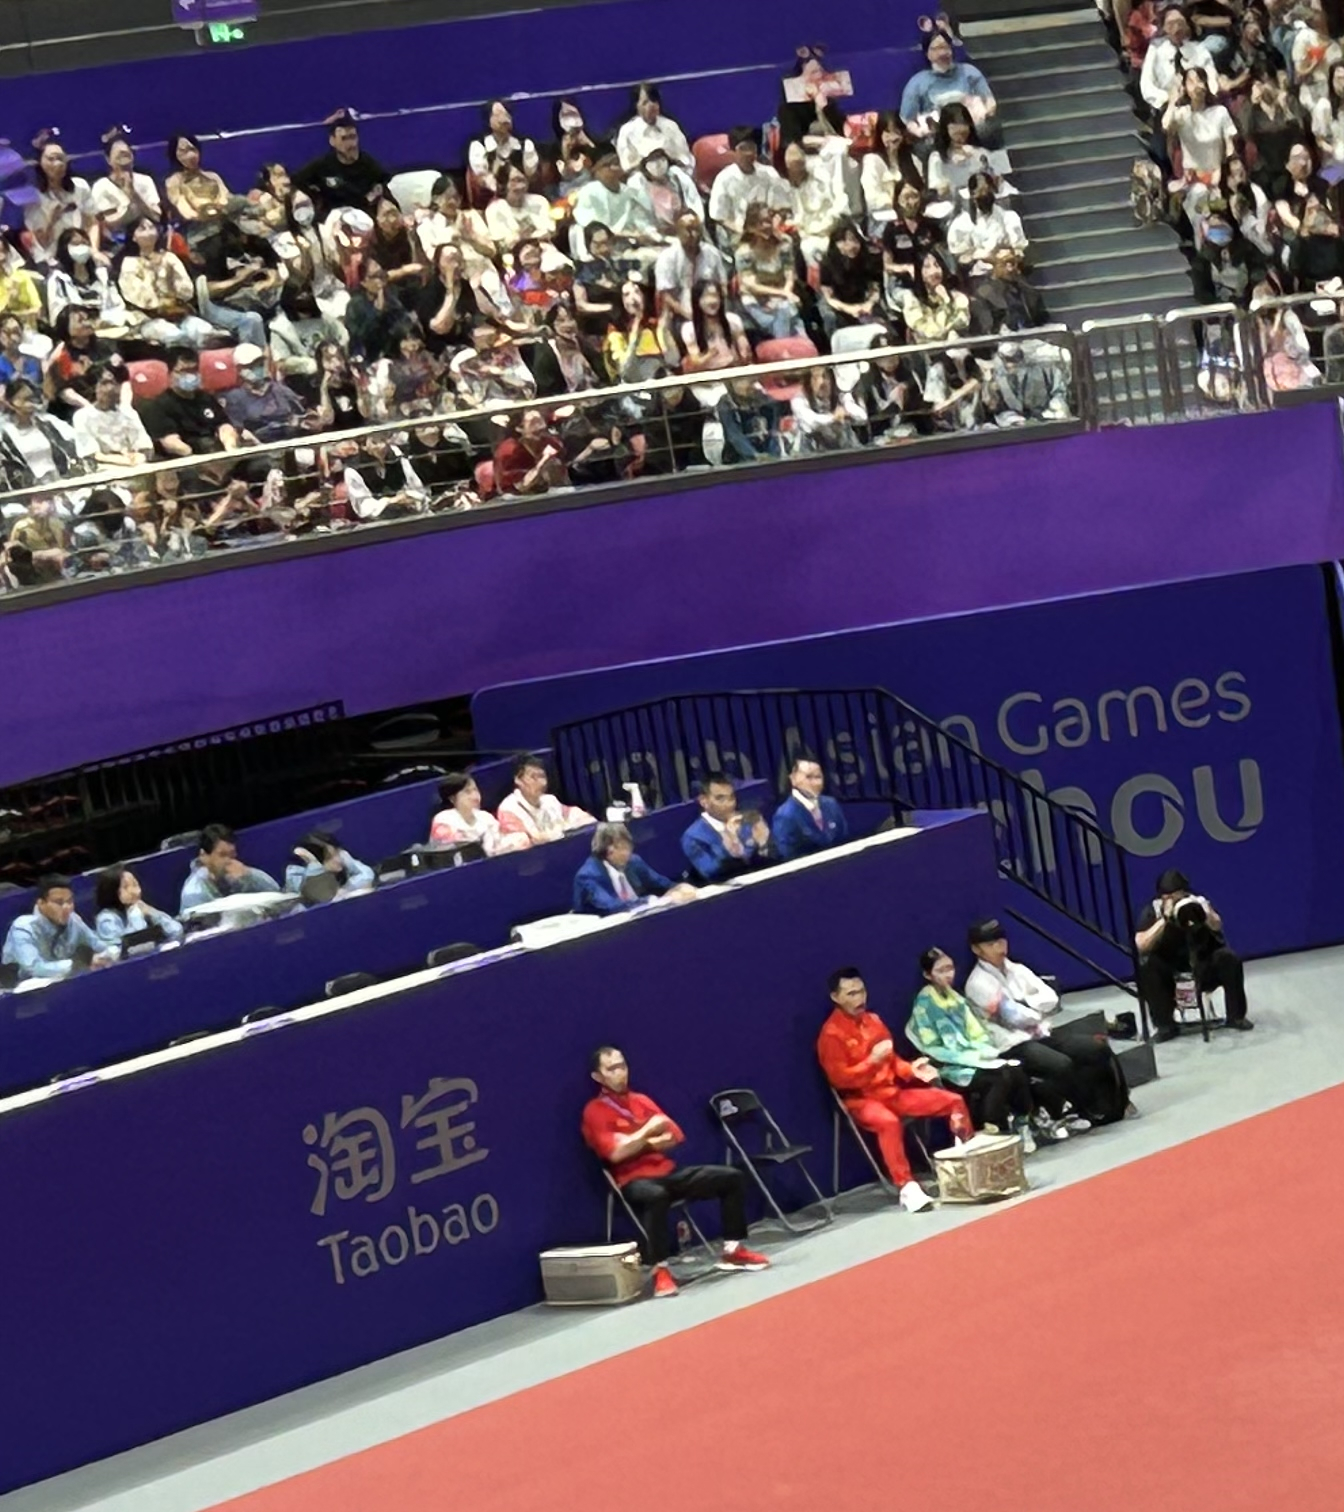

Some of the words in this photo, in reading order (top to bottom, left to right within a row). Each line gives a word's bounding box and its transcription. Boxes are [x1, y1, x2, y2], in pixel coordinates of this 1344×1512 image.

[998, 671, 1251, 755] Games
[303, 1077, 489, 1216] 淘宝
[317, 1193, 498, 1284] Taobao
